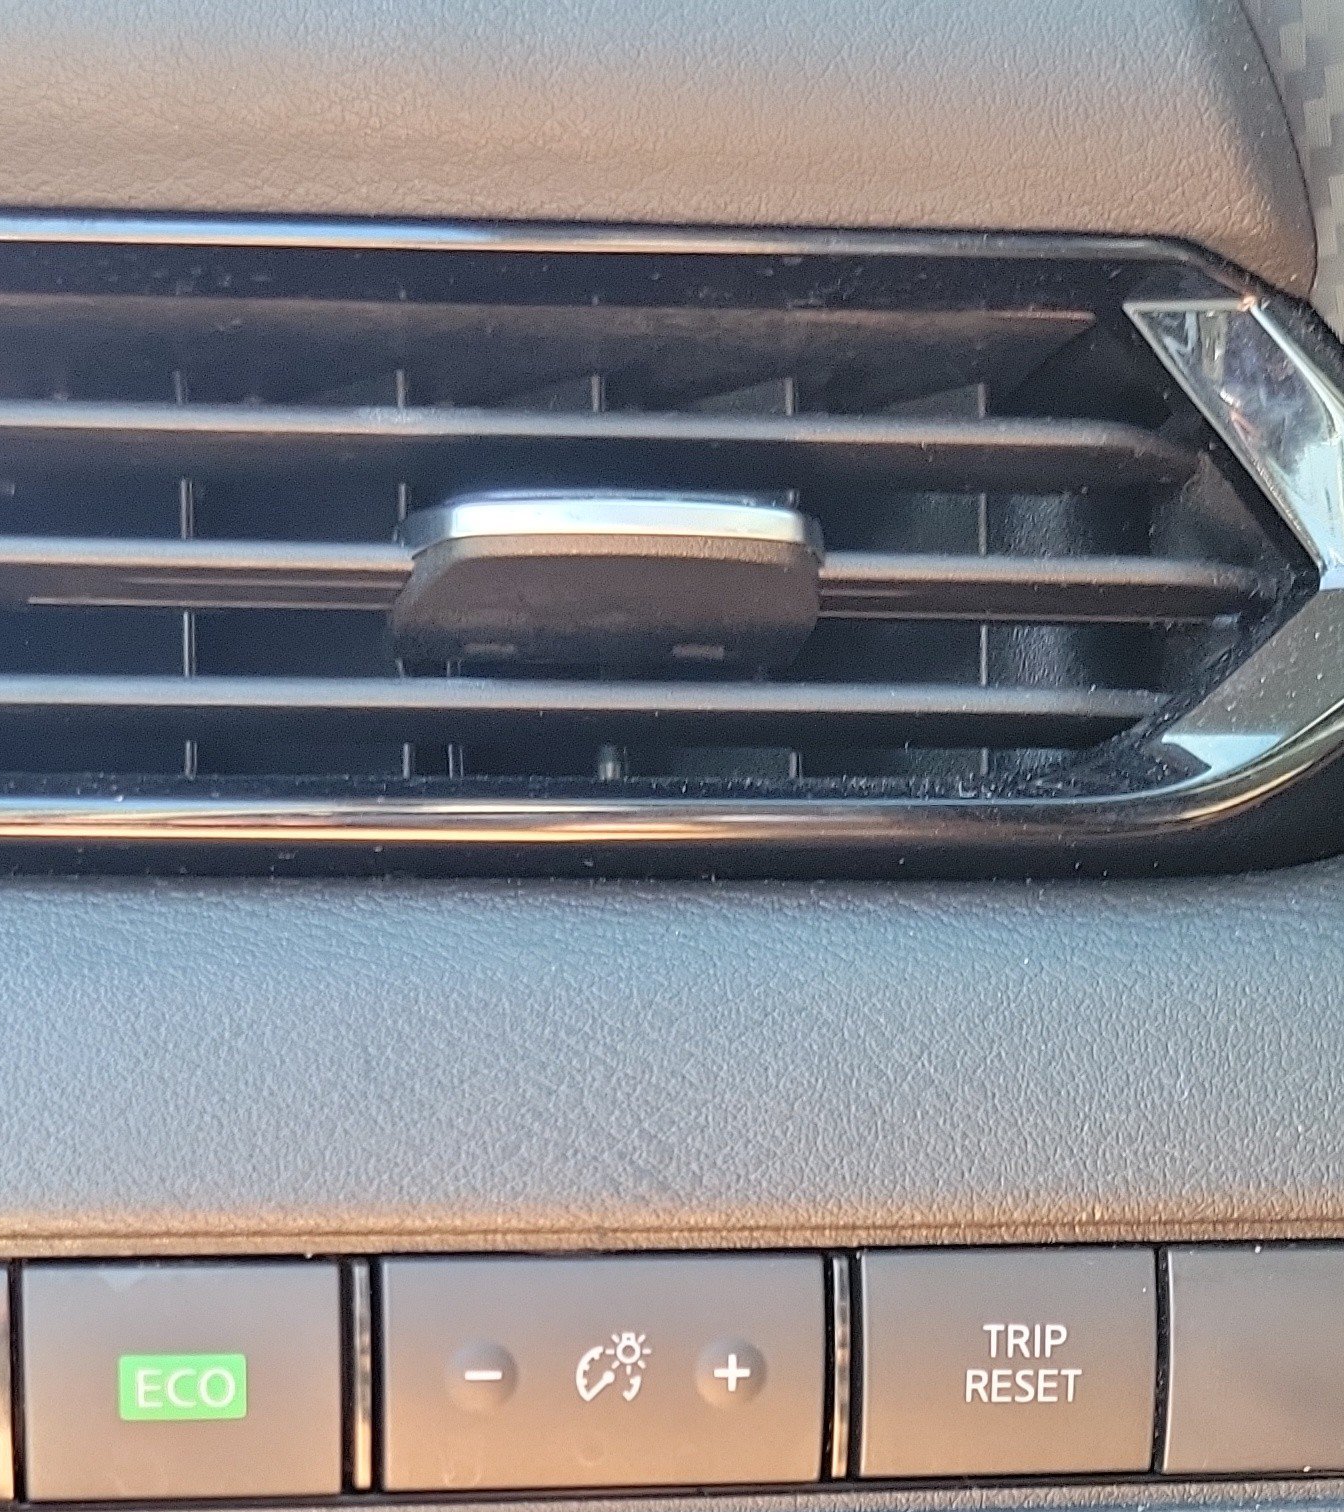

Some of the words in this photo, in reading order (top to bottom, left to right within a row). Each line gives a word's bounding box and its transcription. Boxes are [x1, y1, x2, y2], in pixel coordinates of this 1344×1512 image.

[982, 1323, 1068, 1359] TRIP
[136, 1367, 236, 1409] ECO
[964, 1368, 1083, 1403] RESET
